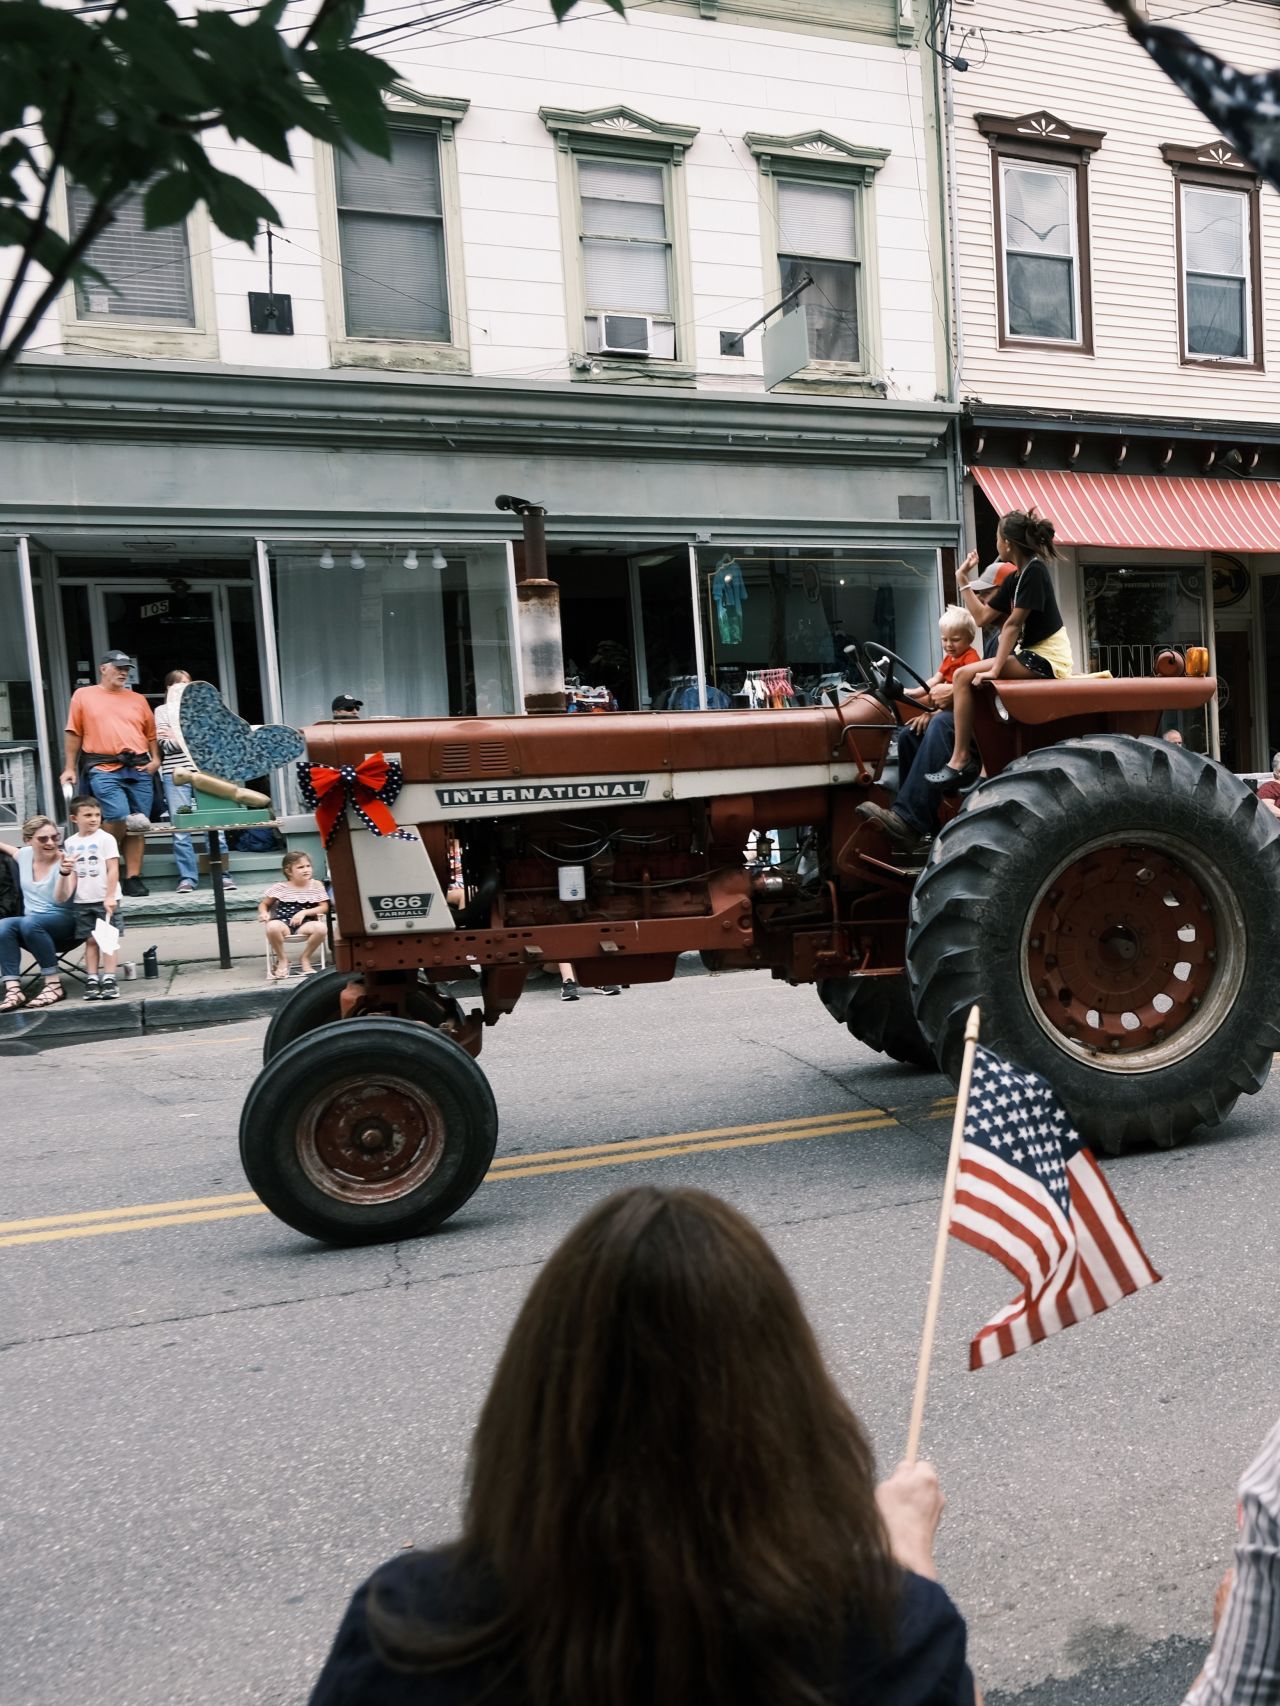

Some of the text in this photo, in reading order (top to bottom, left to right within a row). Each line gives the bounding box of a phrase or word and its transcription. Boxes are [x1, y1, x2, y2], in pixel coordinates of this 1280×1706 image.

[144, 600, 168, 617] 105
[443, 783, 641, 804] INTERNATIONAL
[380, 896, 422, 909] 666
